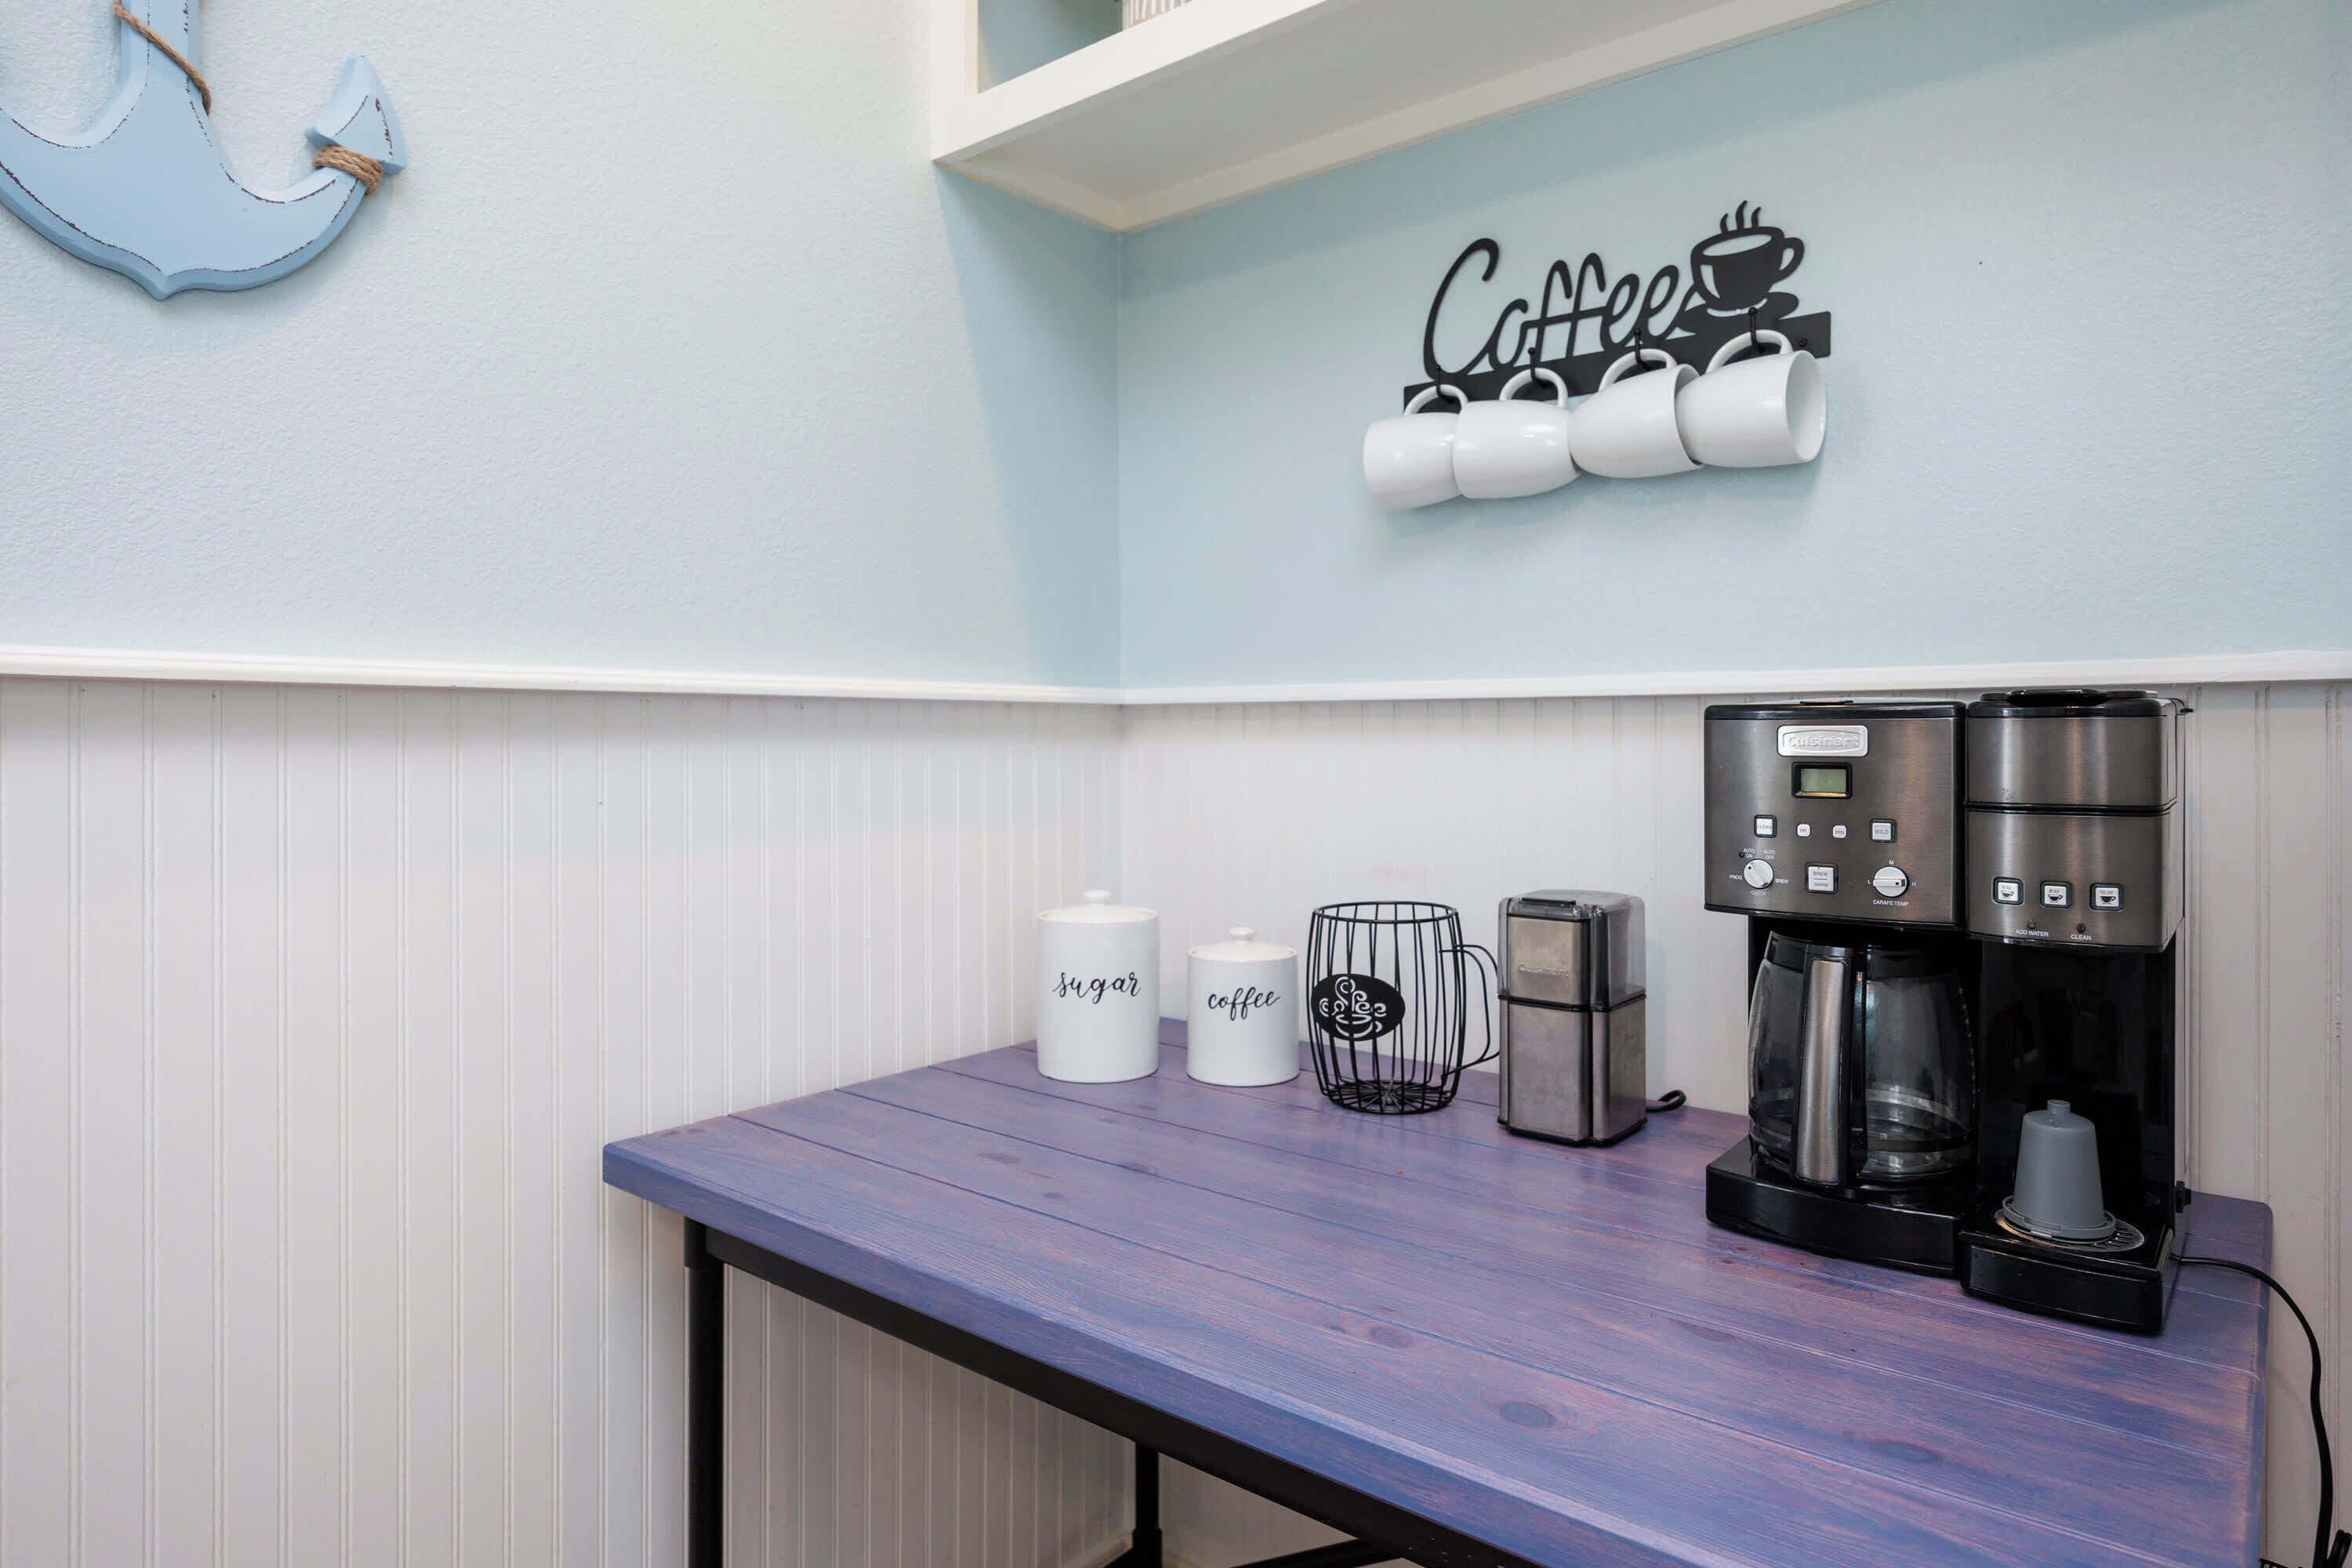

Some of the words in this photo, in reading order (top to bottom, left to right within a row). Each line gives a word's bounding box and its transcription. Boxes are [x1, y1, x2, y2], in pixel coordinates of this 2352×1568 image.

[1423, 238, 1692, 379] Coffee
[1788, 734, 1862, 747] Cuisinart
[1052, 971, 1142, 1004] sugar
[1208, 986, 1280, 1021] coffee
